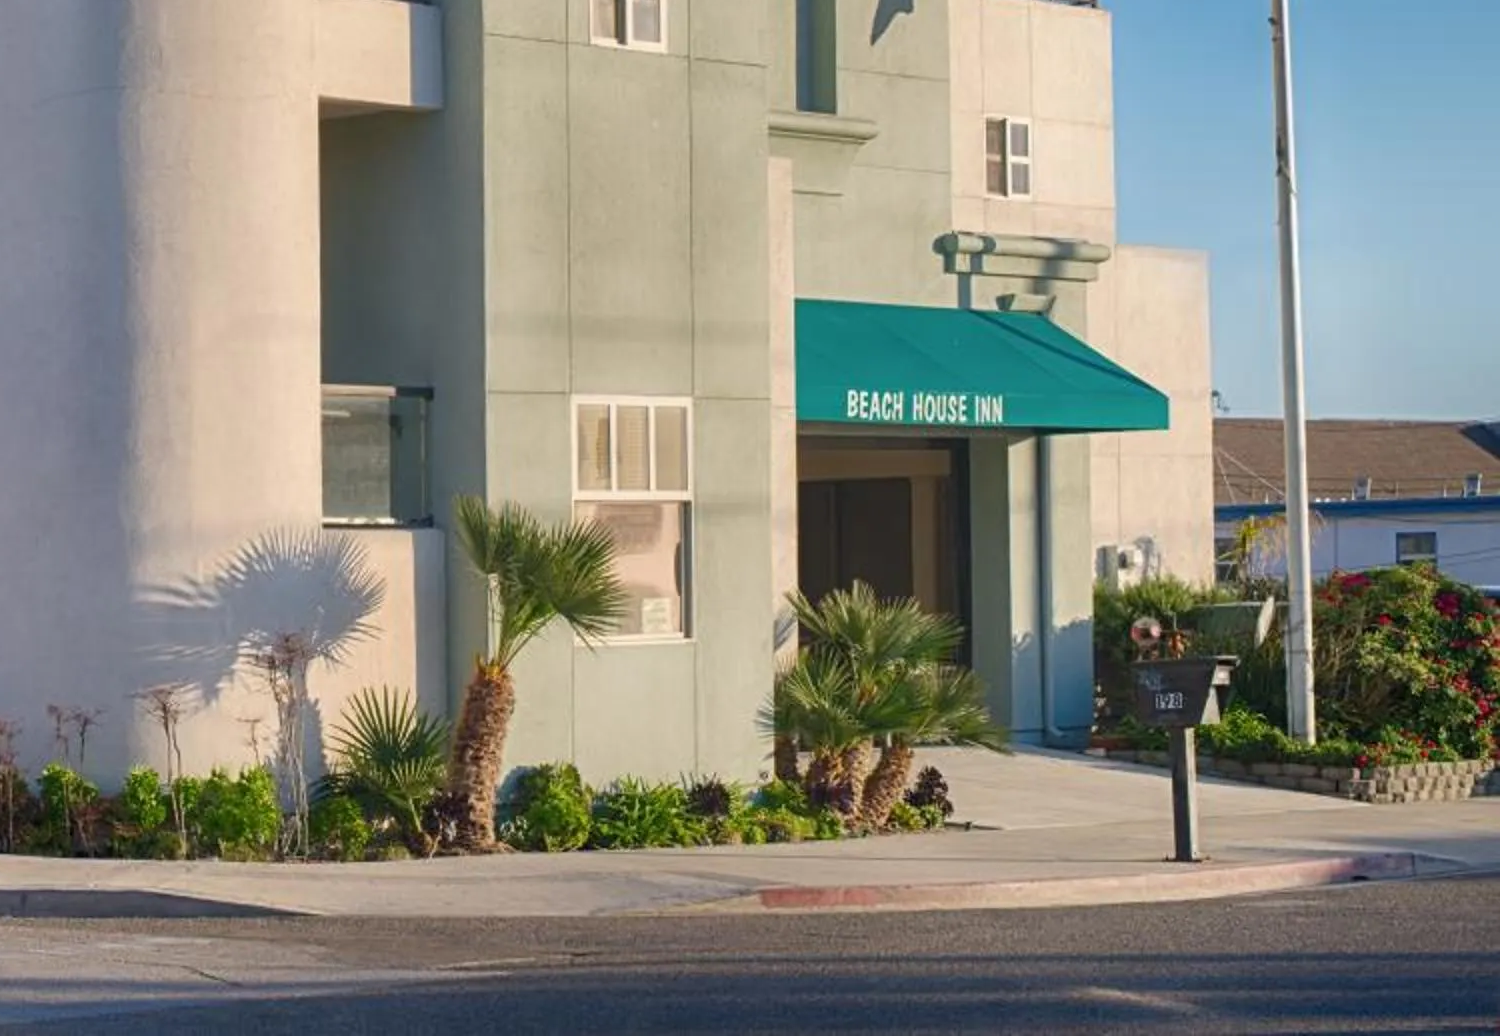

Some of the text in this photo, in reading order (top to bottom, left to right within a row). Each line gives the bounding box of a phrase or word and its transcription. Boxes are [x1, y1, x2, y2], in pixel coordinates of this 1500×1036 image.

[847, 389, 1003, 423] BEACH HOUSE INN
